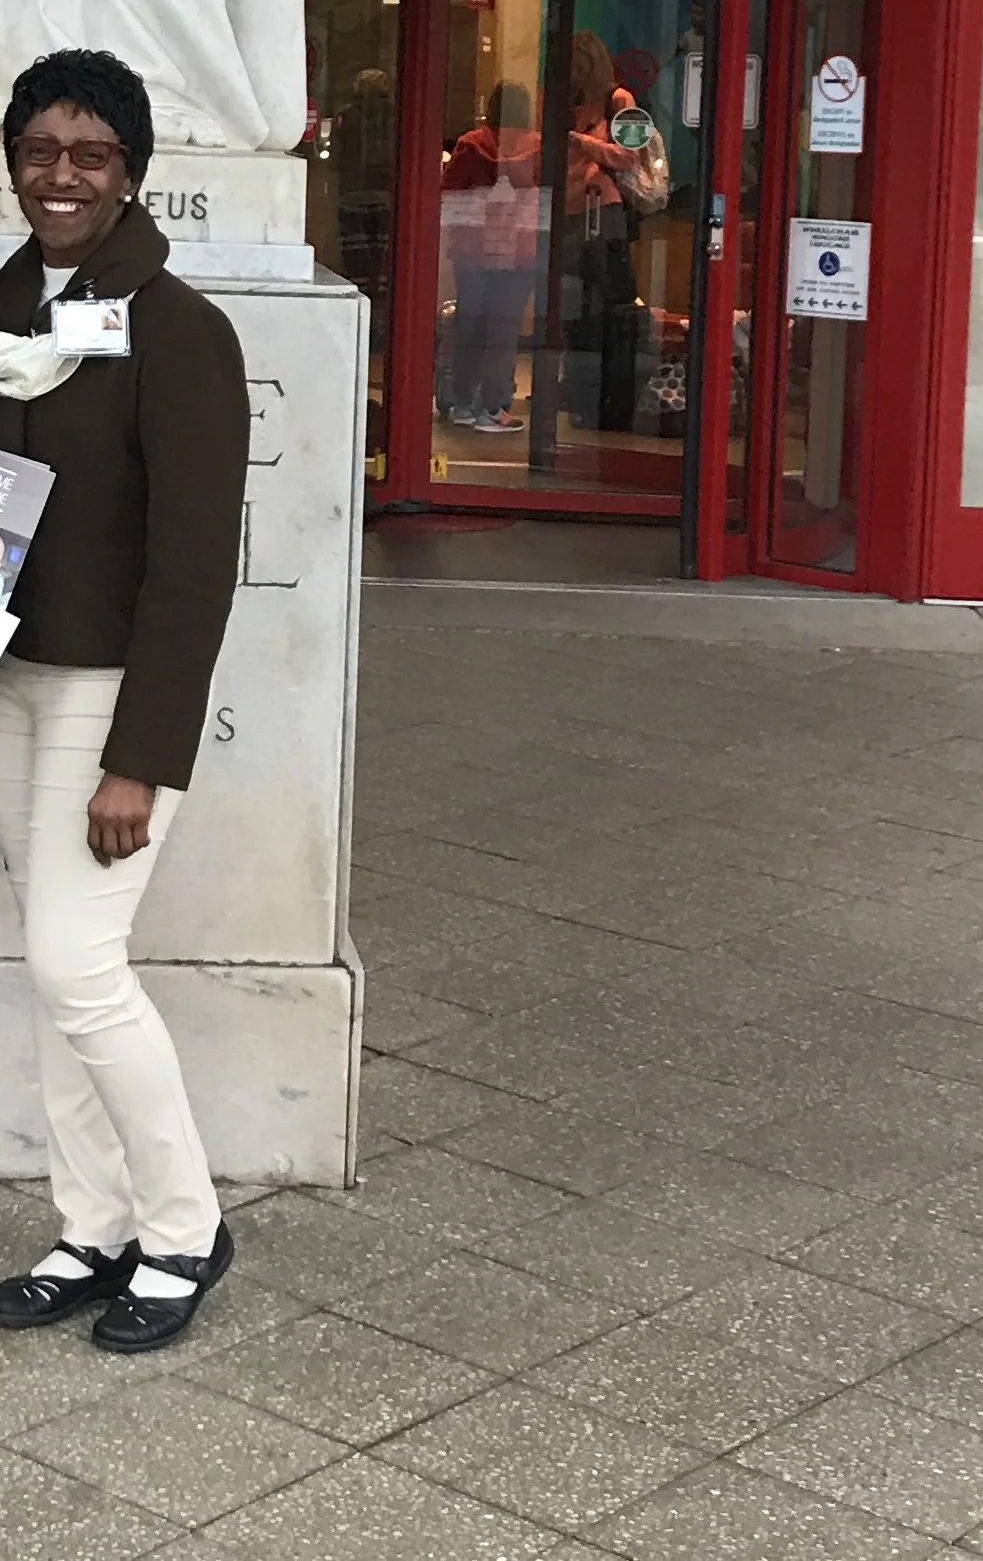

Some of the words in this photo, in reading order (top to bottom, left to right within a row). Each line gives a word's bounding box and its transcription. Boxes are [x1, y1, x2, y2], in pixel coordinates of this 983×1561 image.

[145, 191, 209, 221] EUS
[246, 379, 285, 467] E
[237, 501, 302, 589] L
[215, 706, 235, 742] S
